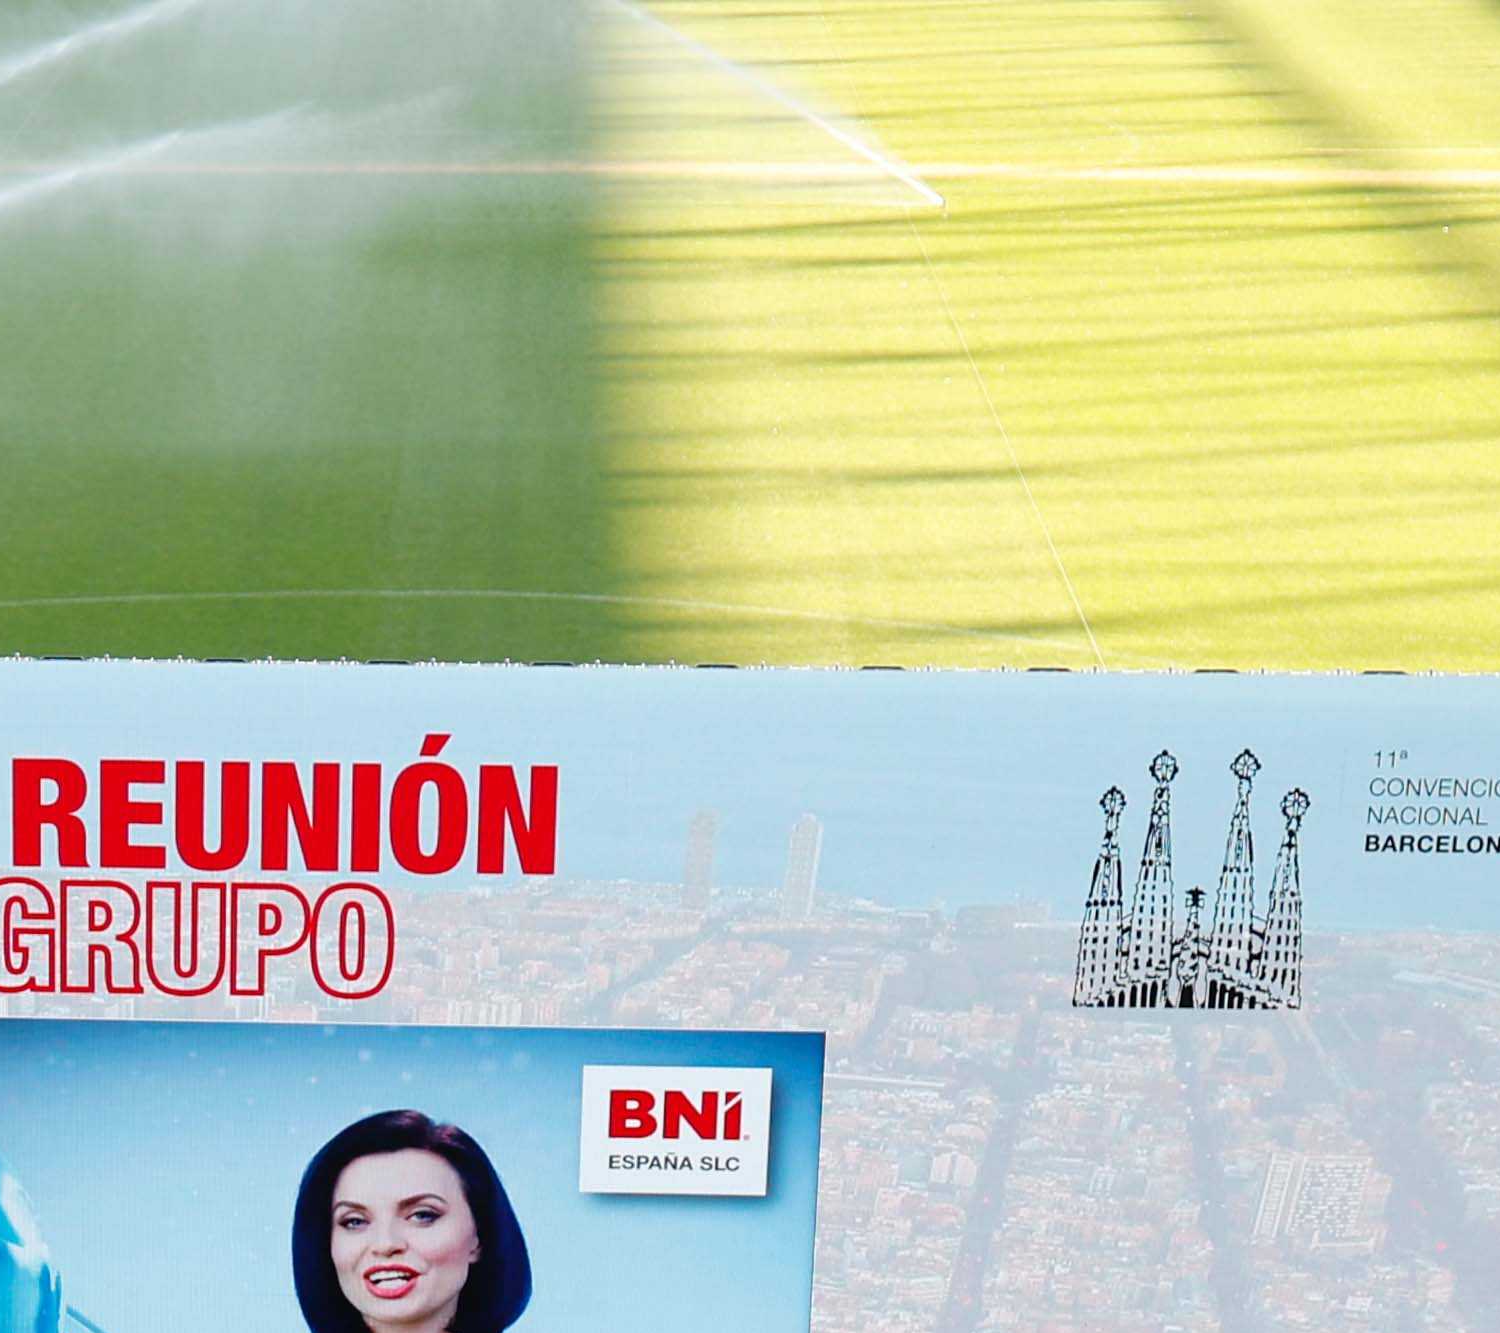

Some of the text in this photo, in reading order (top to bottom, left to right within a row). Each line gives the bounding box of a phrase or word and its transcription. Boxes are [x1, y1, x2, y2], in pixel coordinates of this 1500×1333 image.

[12, 734, 558, 875] REUNIÓN
[1367, 806, 1488, 825] NACIONAL
[608, 1152, 740, 1171] ESPAÑA SLC
